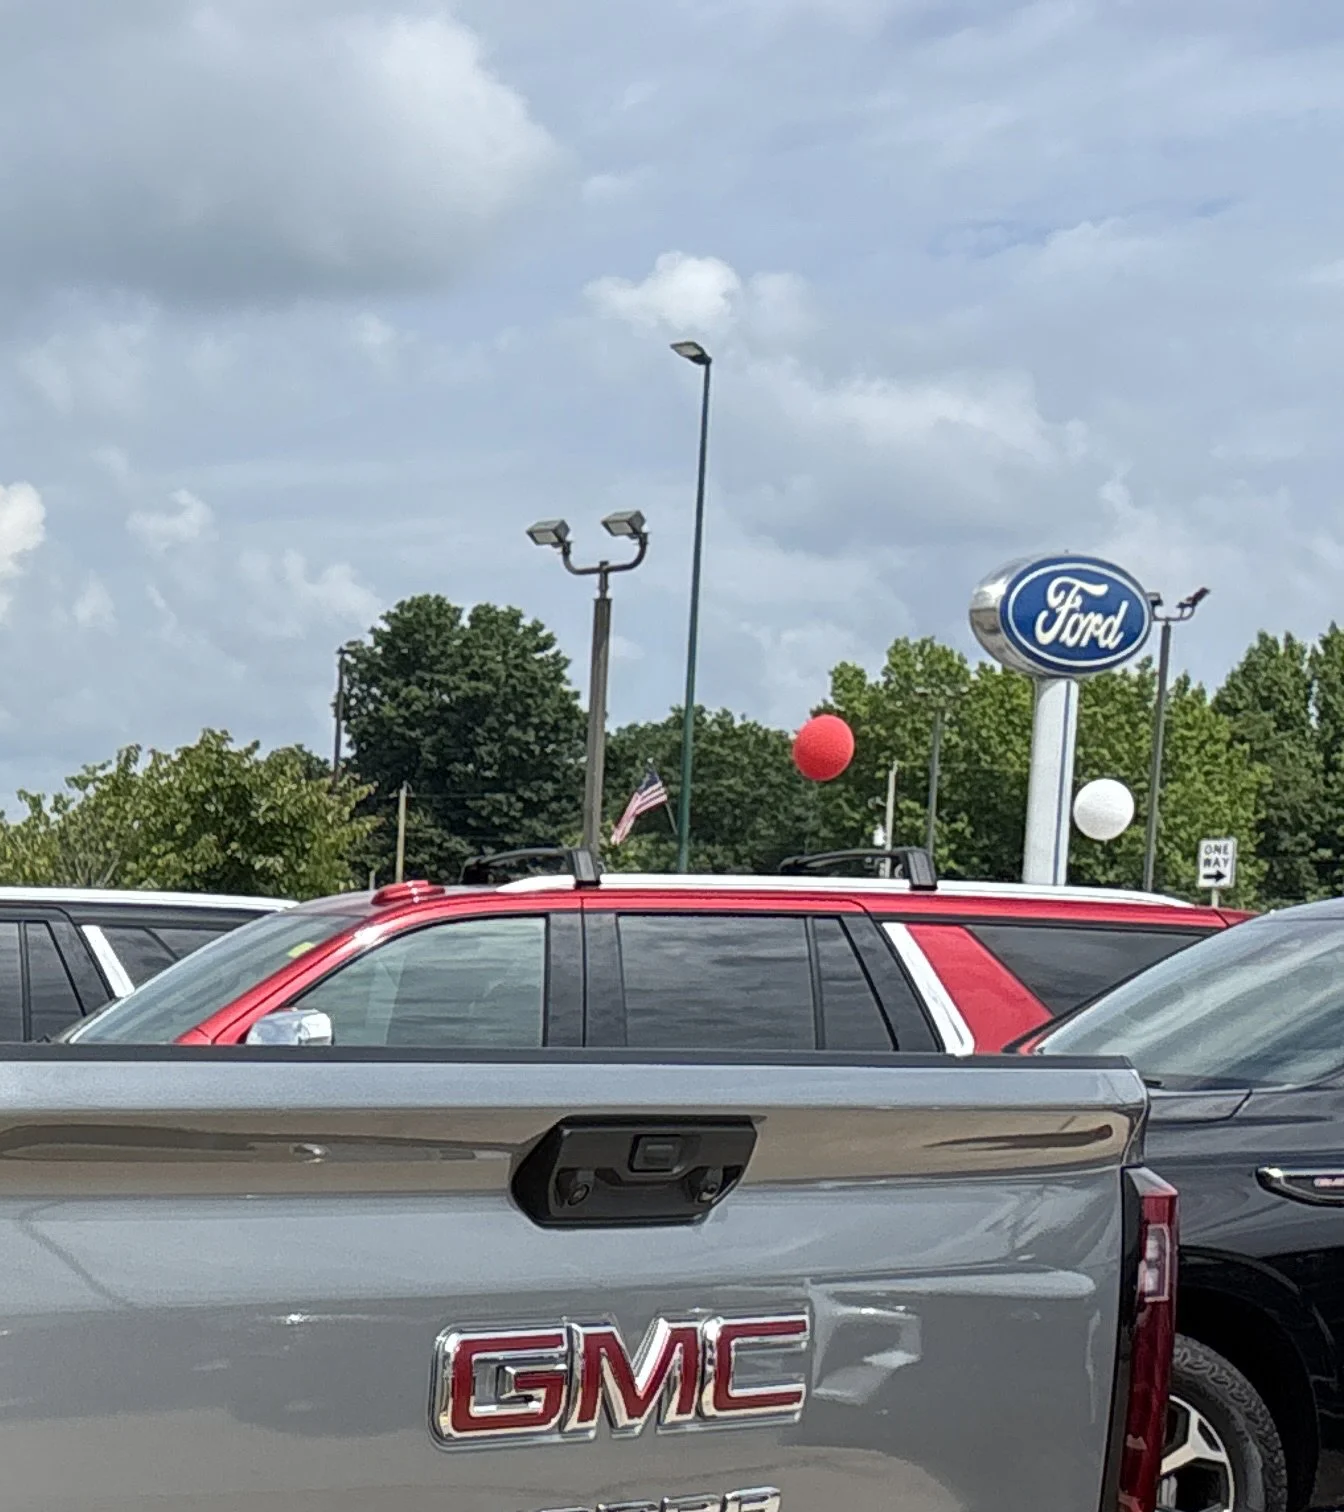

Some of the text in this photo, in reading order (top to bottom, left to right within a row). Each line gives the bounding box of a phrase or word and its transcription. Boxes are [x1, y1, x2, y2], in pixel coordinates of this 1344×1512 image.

[1034, 576, 1129, 650] Ford
[1203, 856, 1230, 868] WAY
[1204, 843, 1230, 855] ONE
[429, 1308, 810, 1450] GMC
